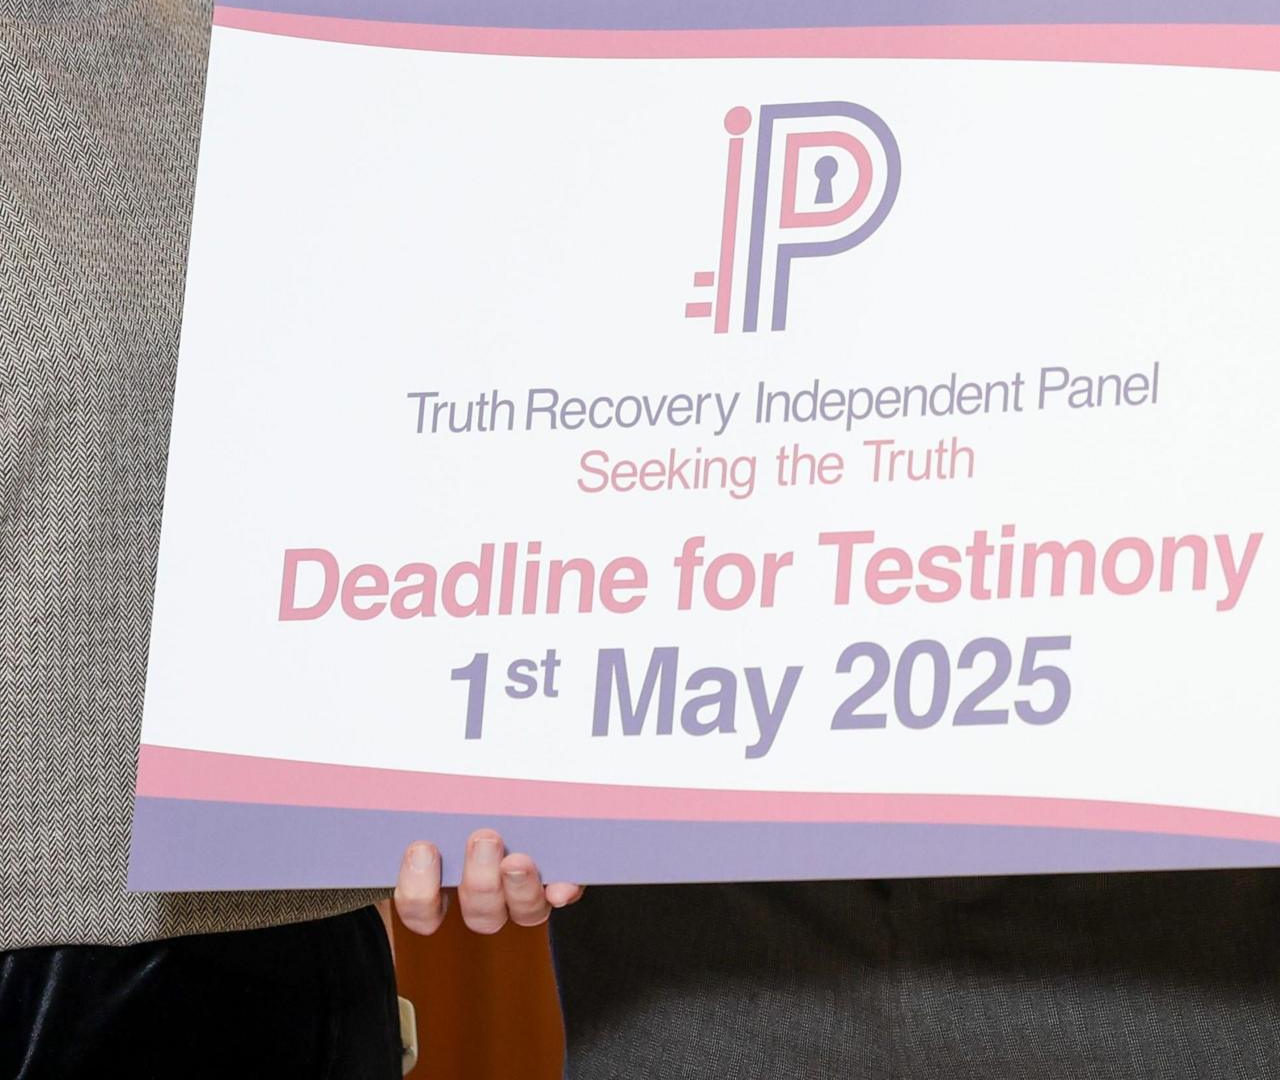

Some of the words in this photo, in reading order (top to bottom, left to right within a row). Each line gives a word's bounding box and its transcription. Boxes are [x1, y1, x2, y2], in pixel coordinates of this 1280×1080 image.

[407, 389, 515, 434] Truth
[526, 388, 740, 436] Recovery
[756, 372, 1025, 432] Independent
[1038, 361, 1159, 409] Panel
[577, 447, 757, 500] Seeking
[776, 444, 845, 488] the
[862, 436, 976, 484] Truth
[277, 539, 649, 623] Deadline
[672, 535, 795, 612] for
[817, 524, 1265, 613] Testimony
[449, 647, 562, 741] 1st
[592, 647, 801, 758] May
[830, 636, 1072, 730] 2025
